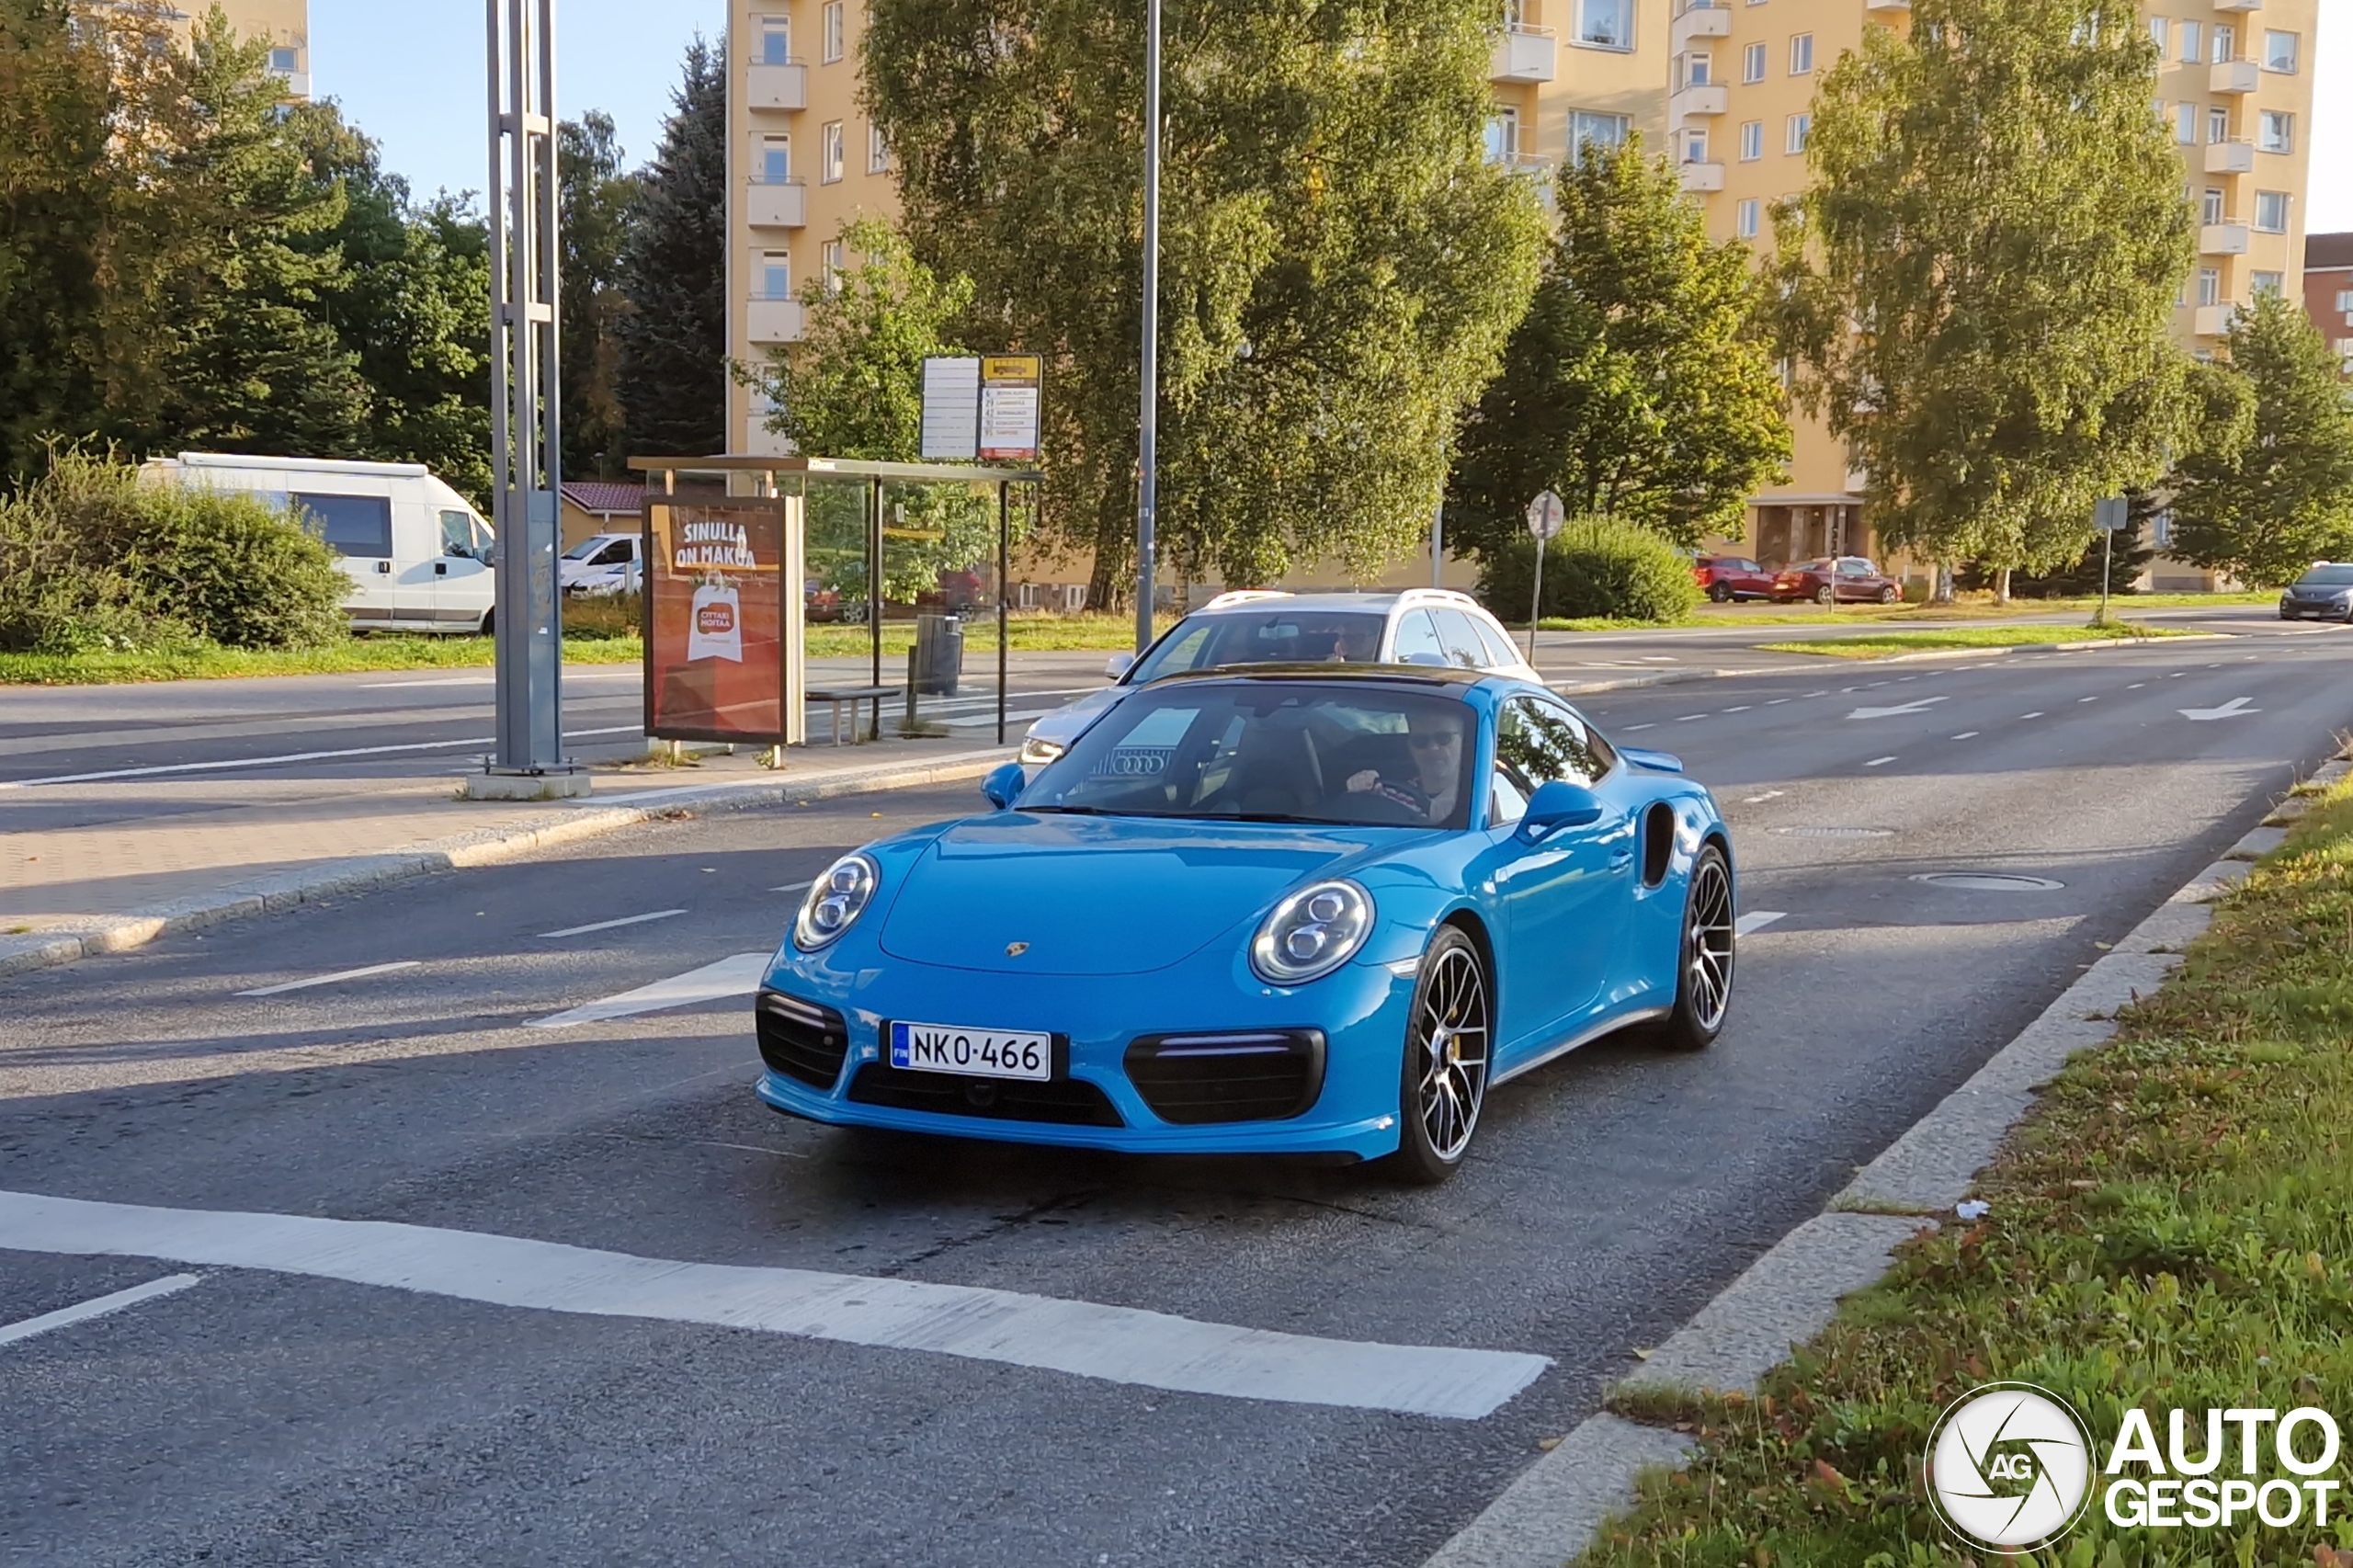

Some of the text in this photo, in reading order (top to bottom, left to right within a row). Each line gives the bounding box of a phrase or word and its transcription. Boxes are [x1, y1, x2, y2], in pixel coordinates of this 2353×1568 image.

[684, 522, 745, 542] SINULLA
[676, 548, 697, 567] ON
[894, 1032, 1040, 1071] FIN NKO-466
